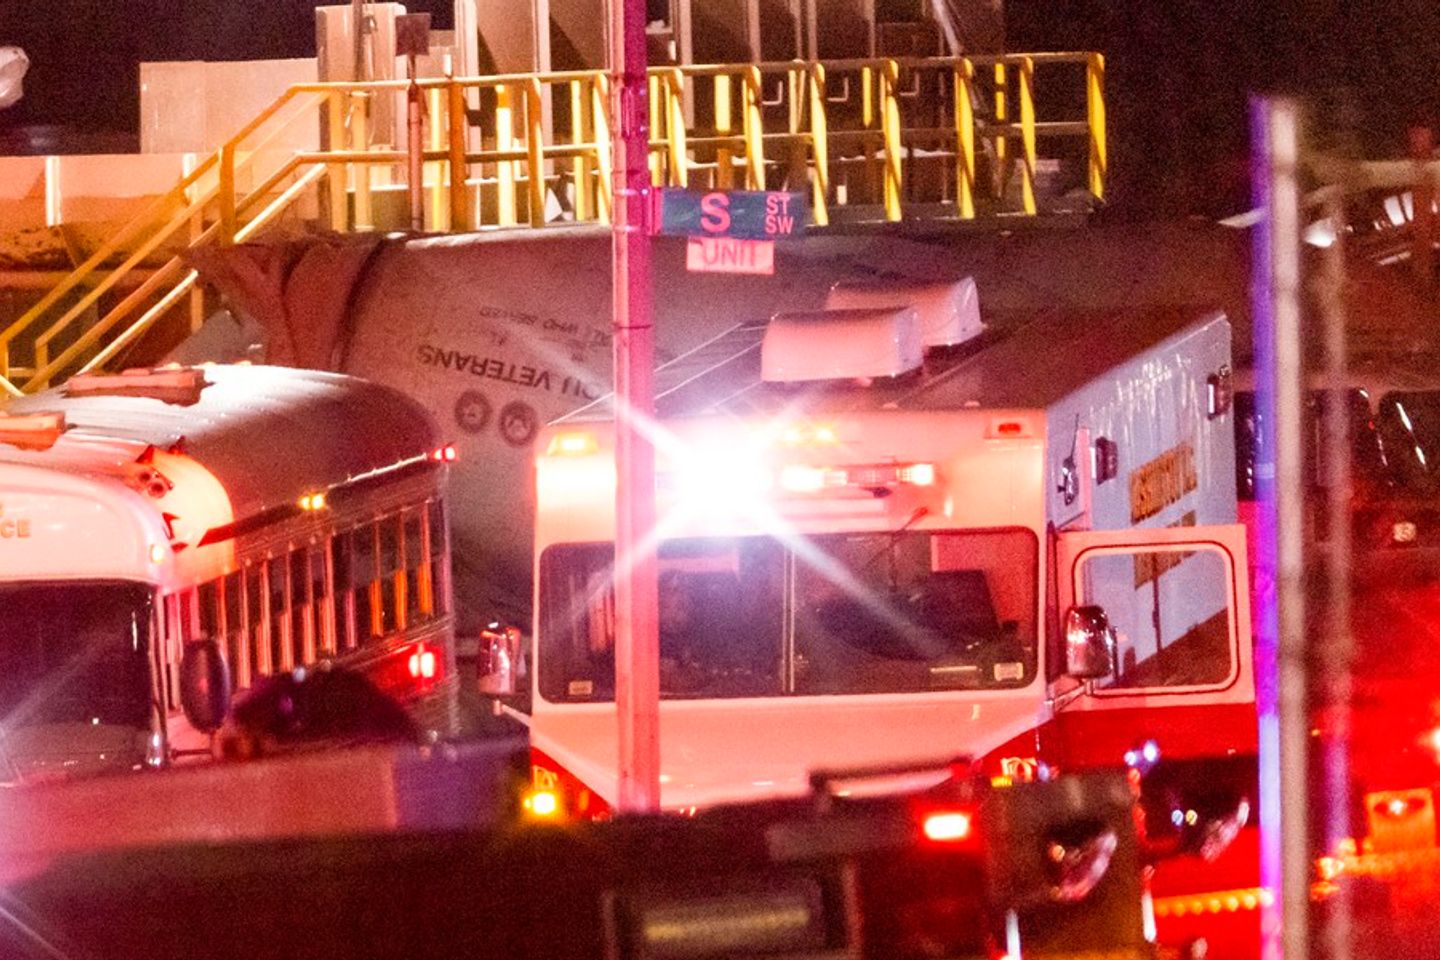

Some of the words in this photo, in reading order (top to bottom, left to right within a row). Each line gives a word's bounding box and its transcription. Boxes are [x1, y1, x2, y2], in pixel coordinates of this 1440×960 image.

[700, 192, 731, 233] S
[766, 195, 791, 215] ST
[765, 216, 793, 234] SW
[702, 240, 757, 266] UNIT
[417, 344, 551, 391] VETERANS
